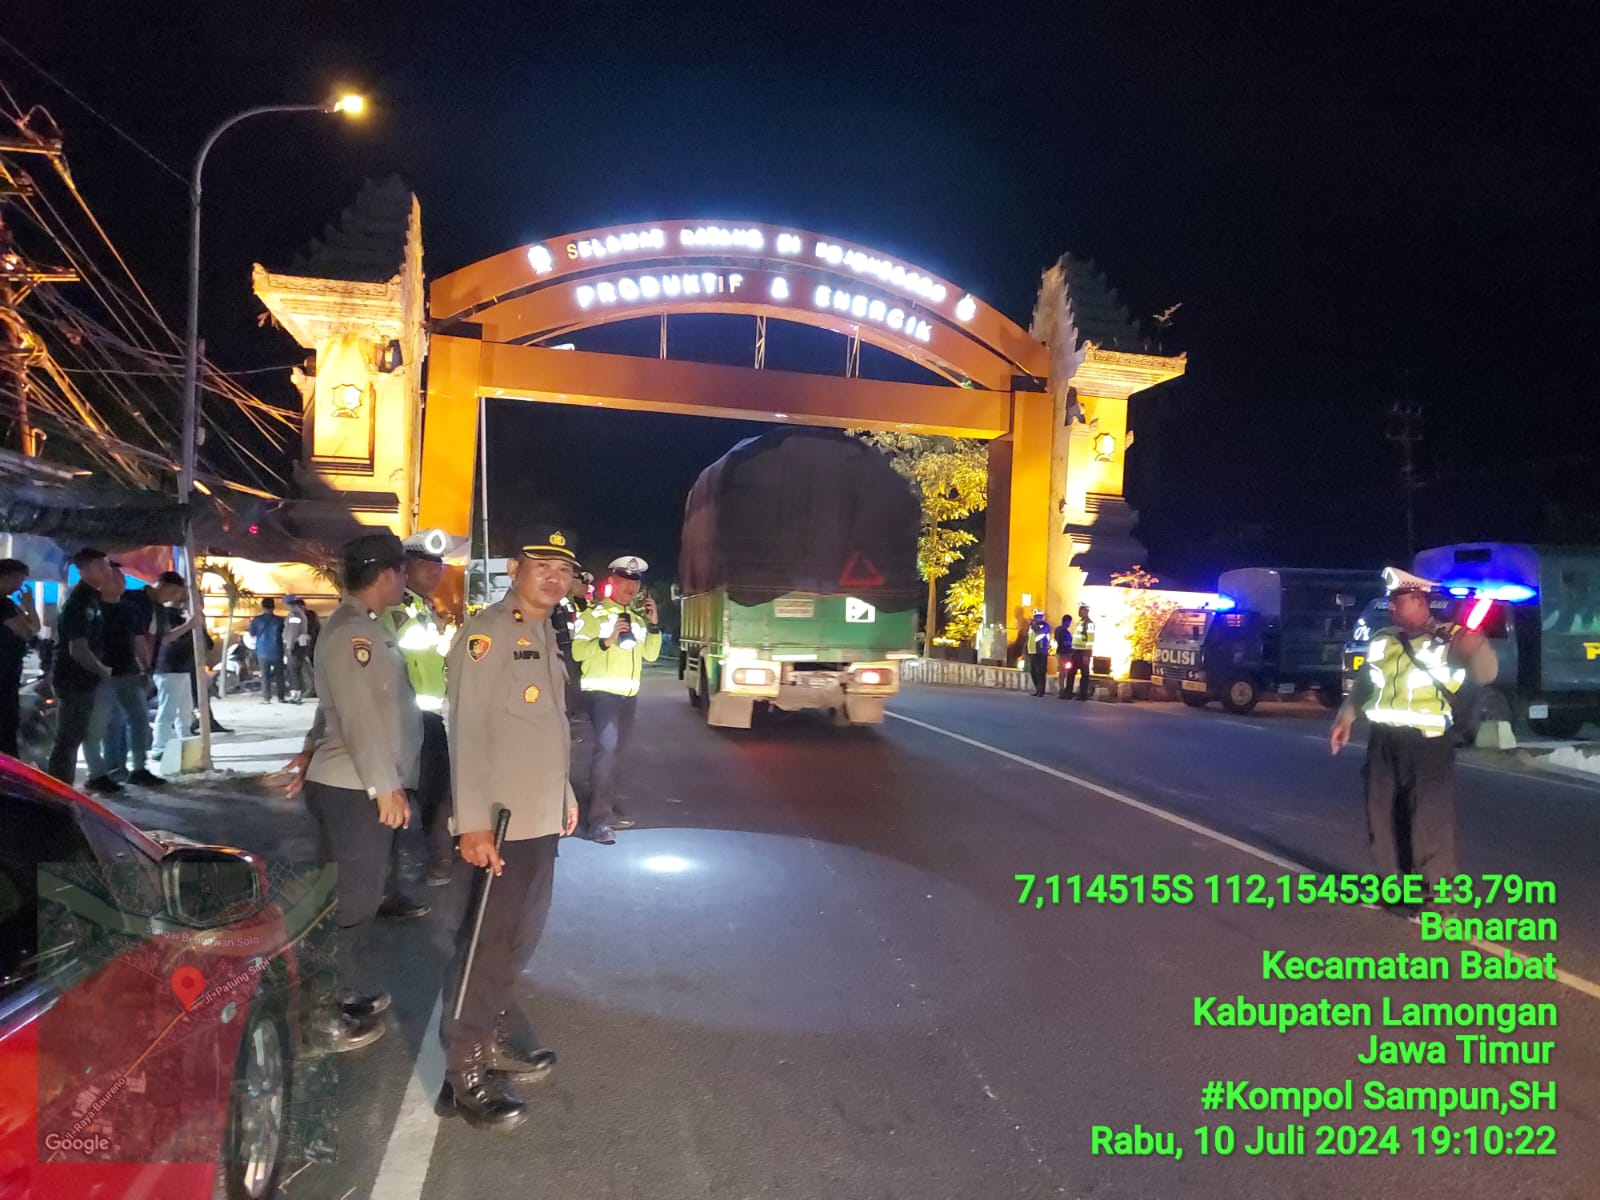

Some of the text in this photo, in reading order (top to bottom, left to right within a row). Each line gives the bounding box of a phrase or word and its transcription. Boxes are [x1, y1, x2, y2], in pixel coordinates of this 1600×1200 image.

[576, 272, 744, 309] PRODUKTIF
[815, 285, 933, 343] ENERGIK
[1154, 648, 1196, 666] POLISI
